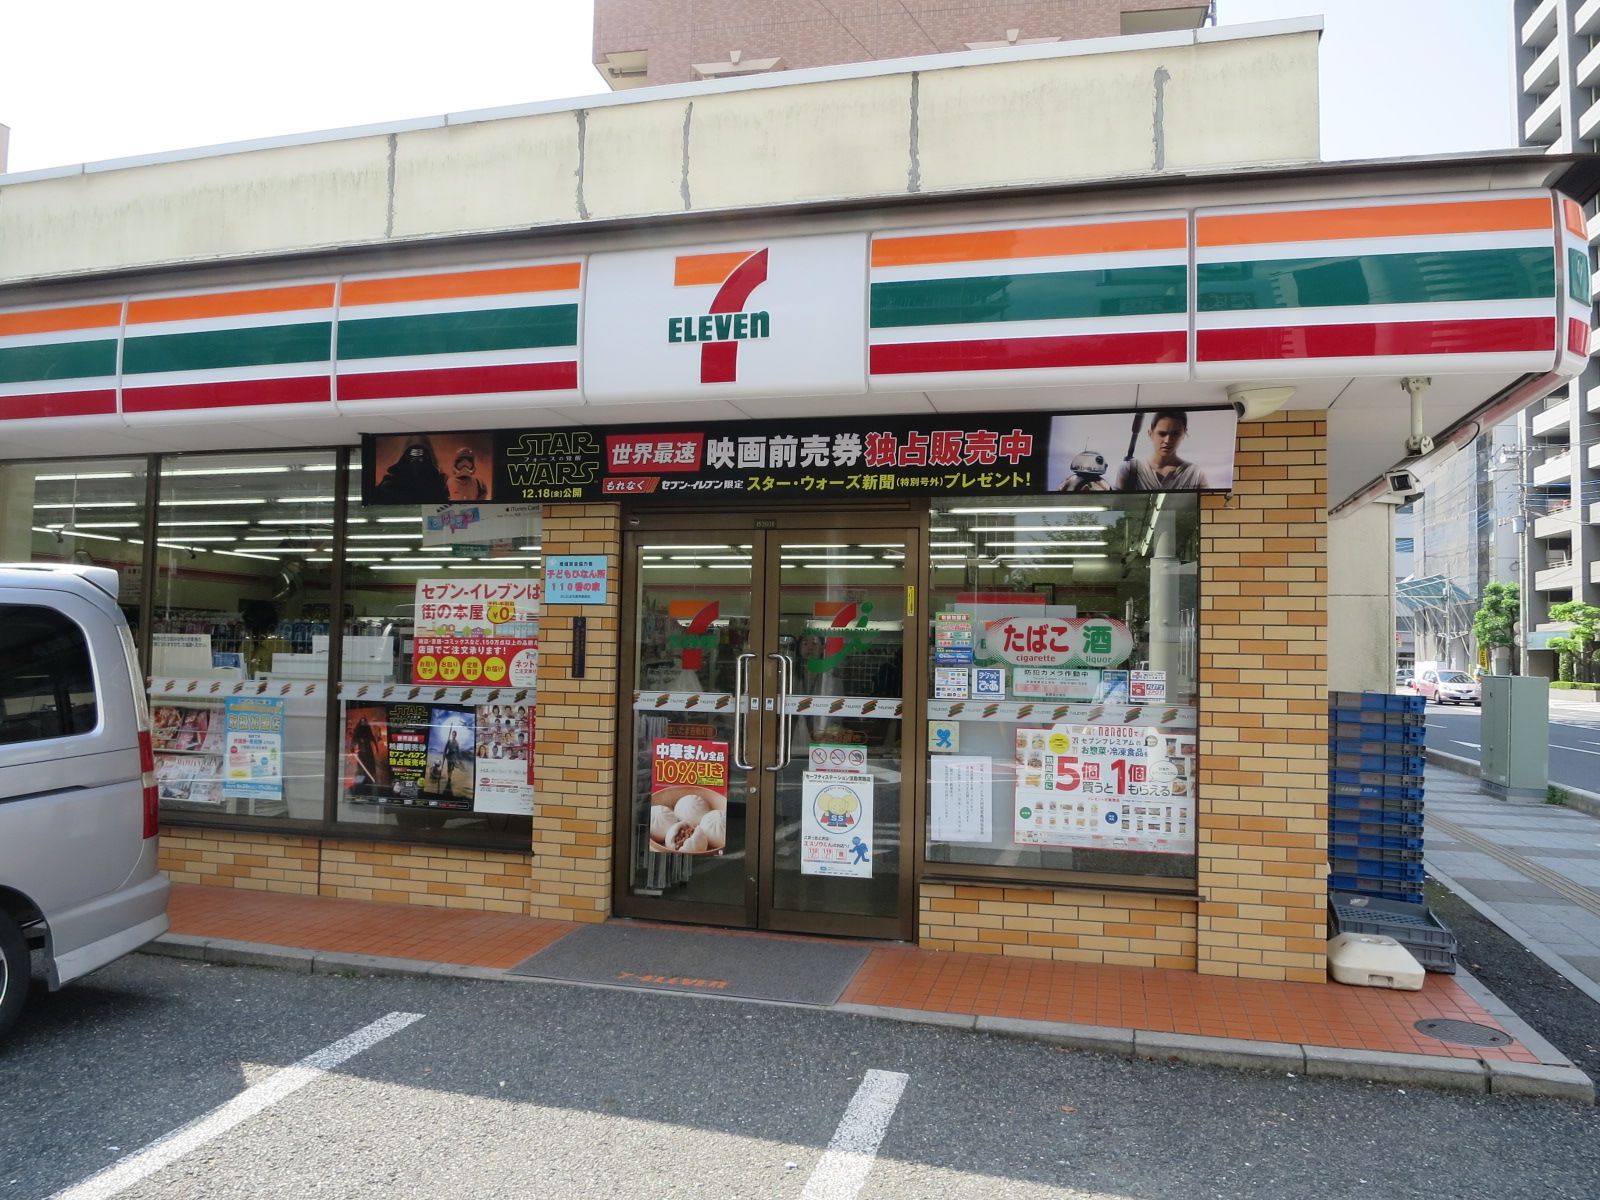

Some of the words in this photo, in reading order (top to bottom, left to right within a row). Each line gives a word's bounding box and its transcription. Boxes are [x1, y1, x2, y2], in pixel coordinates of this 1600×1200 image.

[507, 432, 600, 457] STAR
[611, 441, 698, 466] 世界最速
[507, 462, 600, 486] WARS
[606, 481, 646, 491] もれなく
[547, 570, 606, 579] 子どもひなん所
[422, 604, 484, 620] 街の本屋
[1003, 624, 1070, 653] たばこ
[1083, 625, 1112, 654] 酒
[1016, 654, 1056, 664] cigarette
[1086, 655, 1113, 664] liquor
[1024, 669, 1089, 677] 防犯カメラ作動中
[1081, 738, 1141, 746] セブンプレミアムの
[1082, 781, 1114, 794] 買うと
[1128, 783, 1170, 797] もらえる
